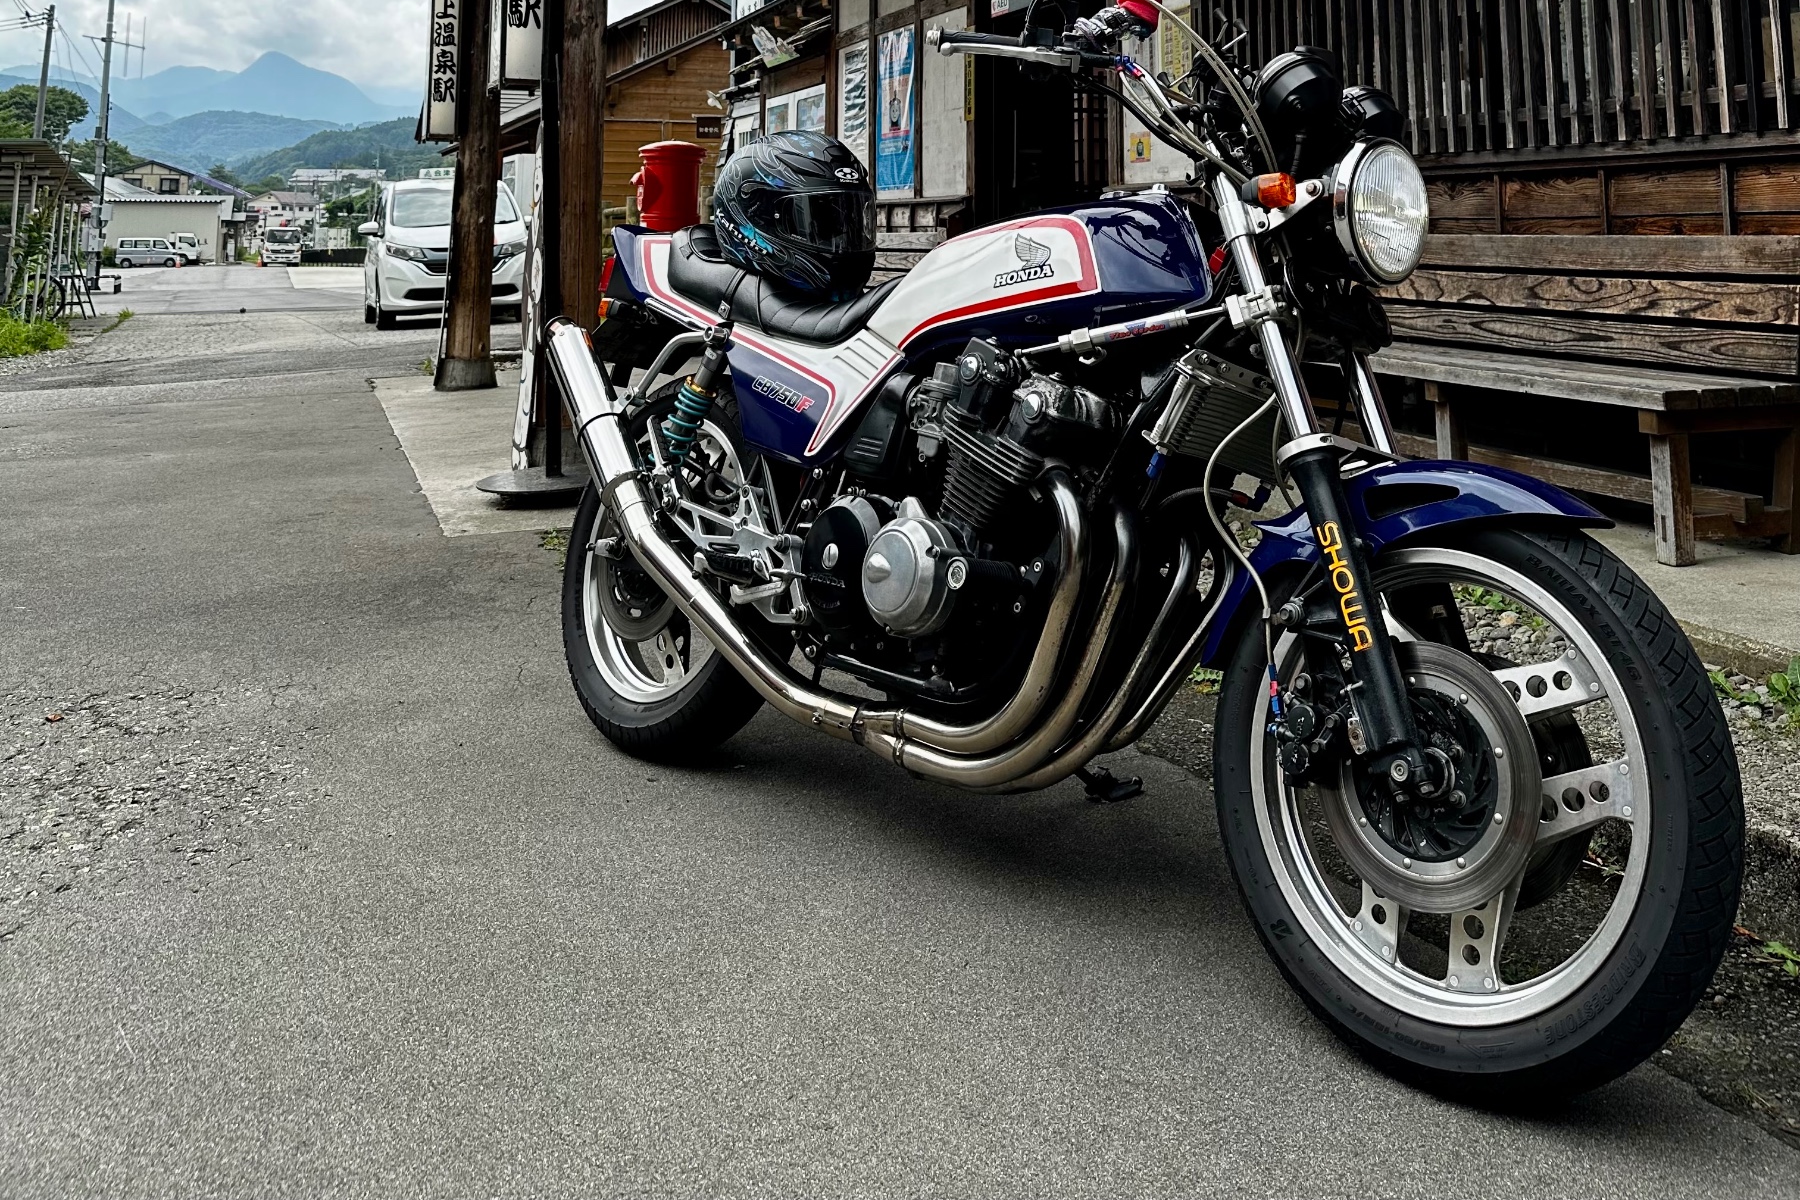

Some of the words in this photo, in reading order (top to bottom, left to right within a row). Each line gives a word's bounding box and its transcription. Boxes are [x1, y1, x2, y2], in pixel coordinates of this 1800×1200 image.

[993, 264, 1055, 289] HONDA
[751, 375, 815, 413] CB750F
[809, 572, 846, 588] HONDA
[1316, 520, 1373, 652] SHOWA
[1525, 553, 1601, 619] BATTLAX
[1544, 941, 1647, 1046] BRIDGESTONE
